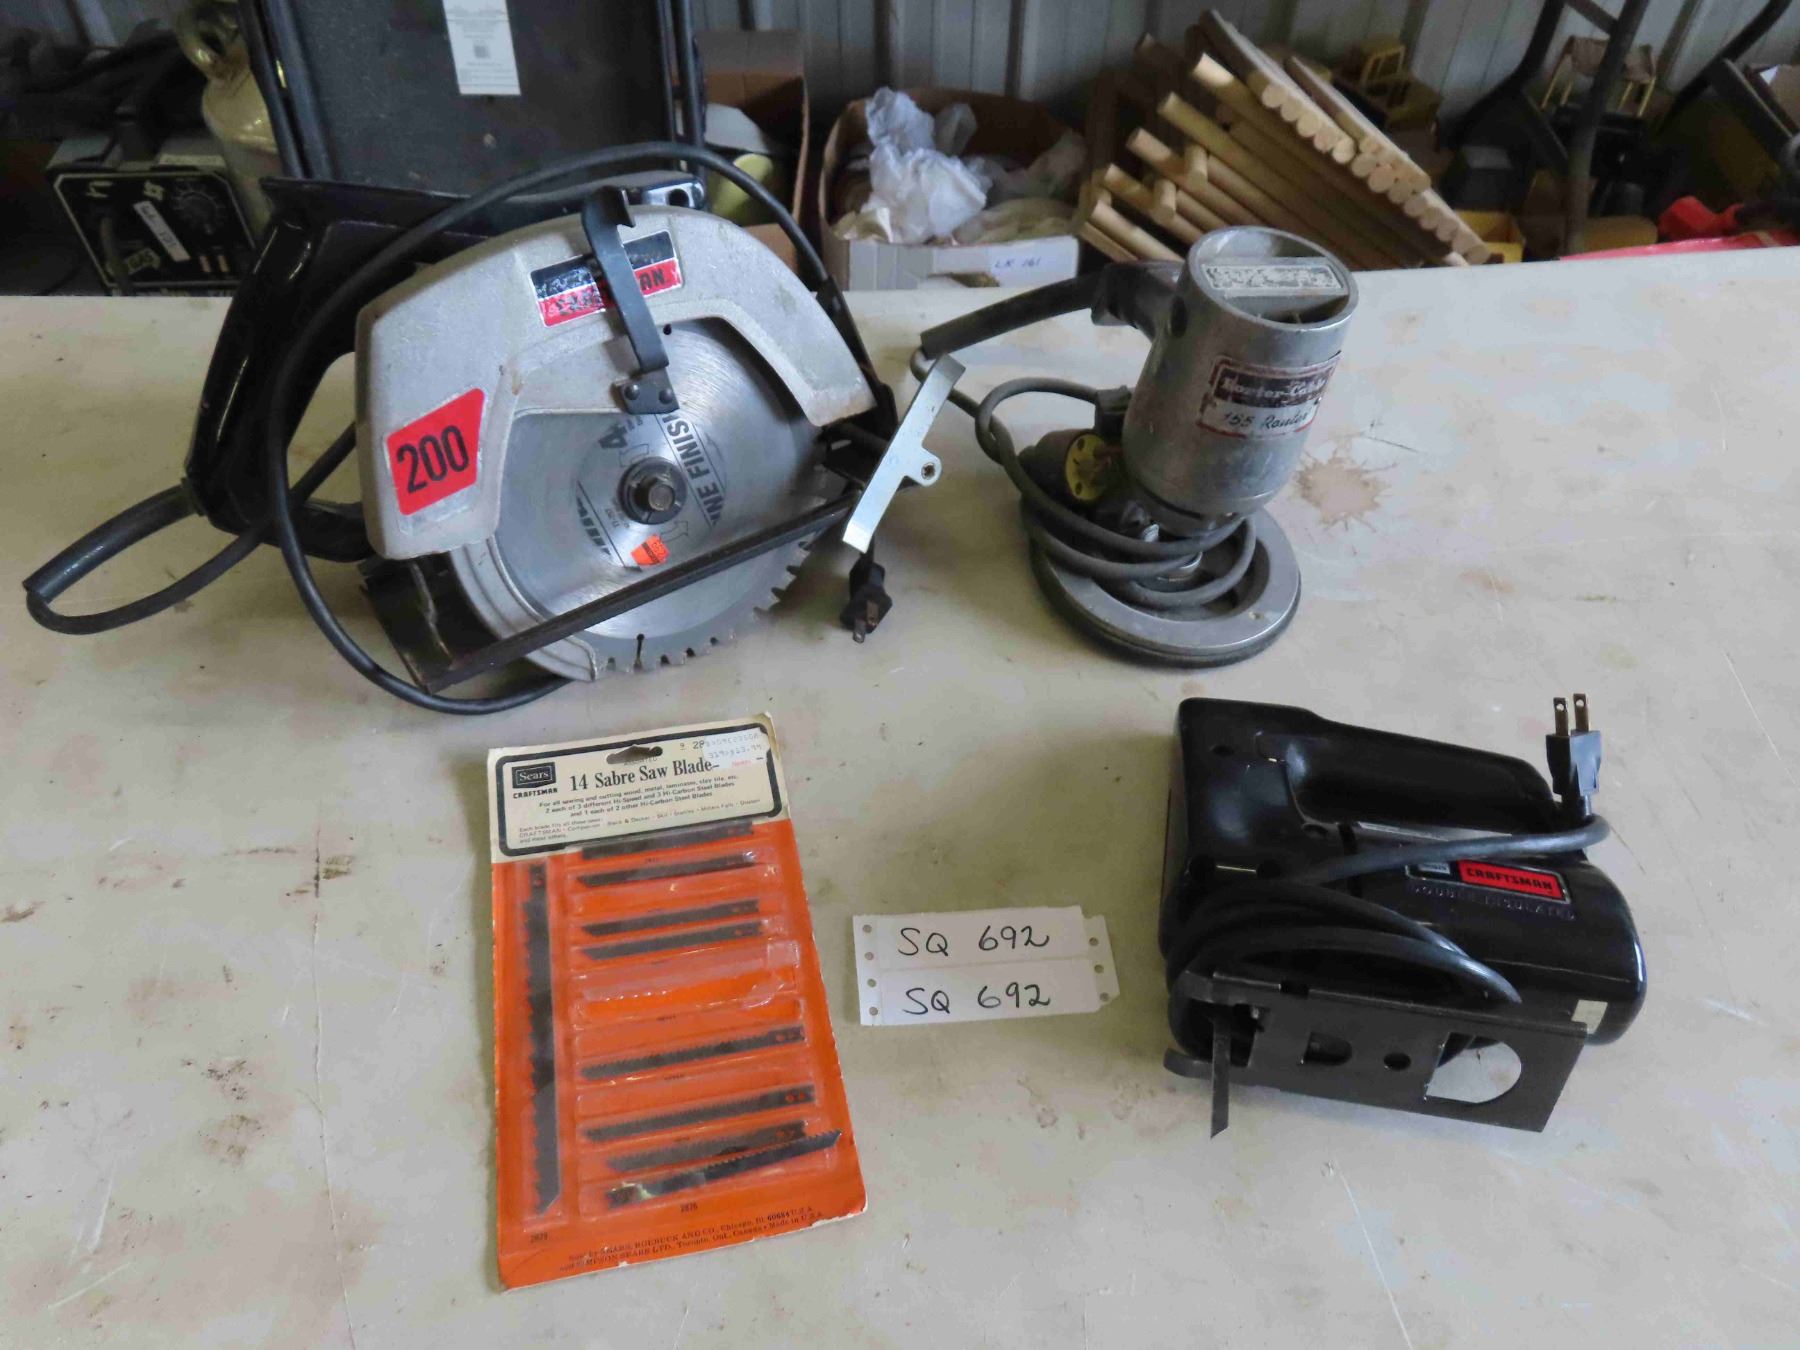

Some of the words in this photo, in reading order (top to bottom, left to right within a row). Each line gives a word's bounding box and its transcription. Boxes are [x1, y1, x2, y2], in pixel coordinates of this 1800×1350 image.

[396, 425, 470, 494] 200
[519, 771, 549, 781] Sears
[569, 773, 588, 791] 14
[595, 770, 635, 789] Sabre
[639, 765, 668, 782] Saw
[513, 788, 558, 799] CRAFTSMAN
[1466, 867, 1553, 890] CRAFTSMAN
[898, 927, 949, 957] SQ
[978, 925, 1049, 951] 692
[903, 987, 950, 1014] SQ
[977, 982, 1050, 1008] 692
